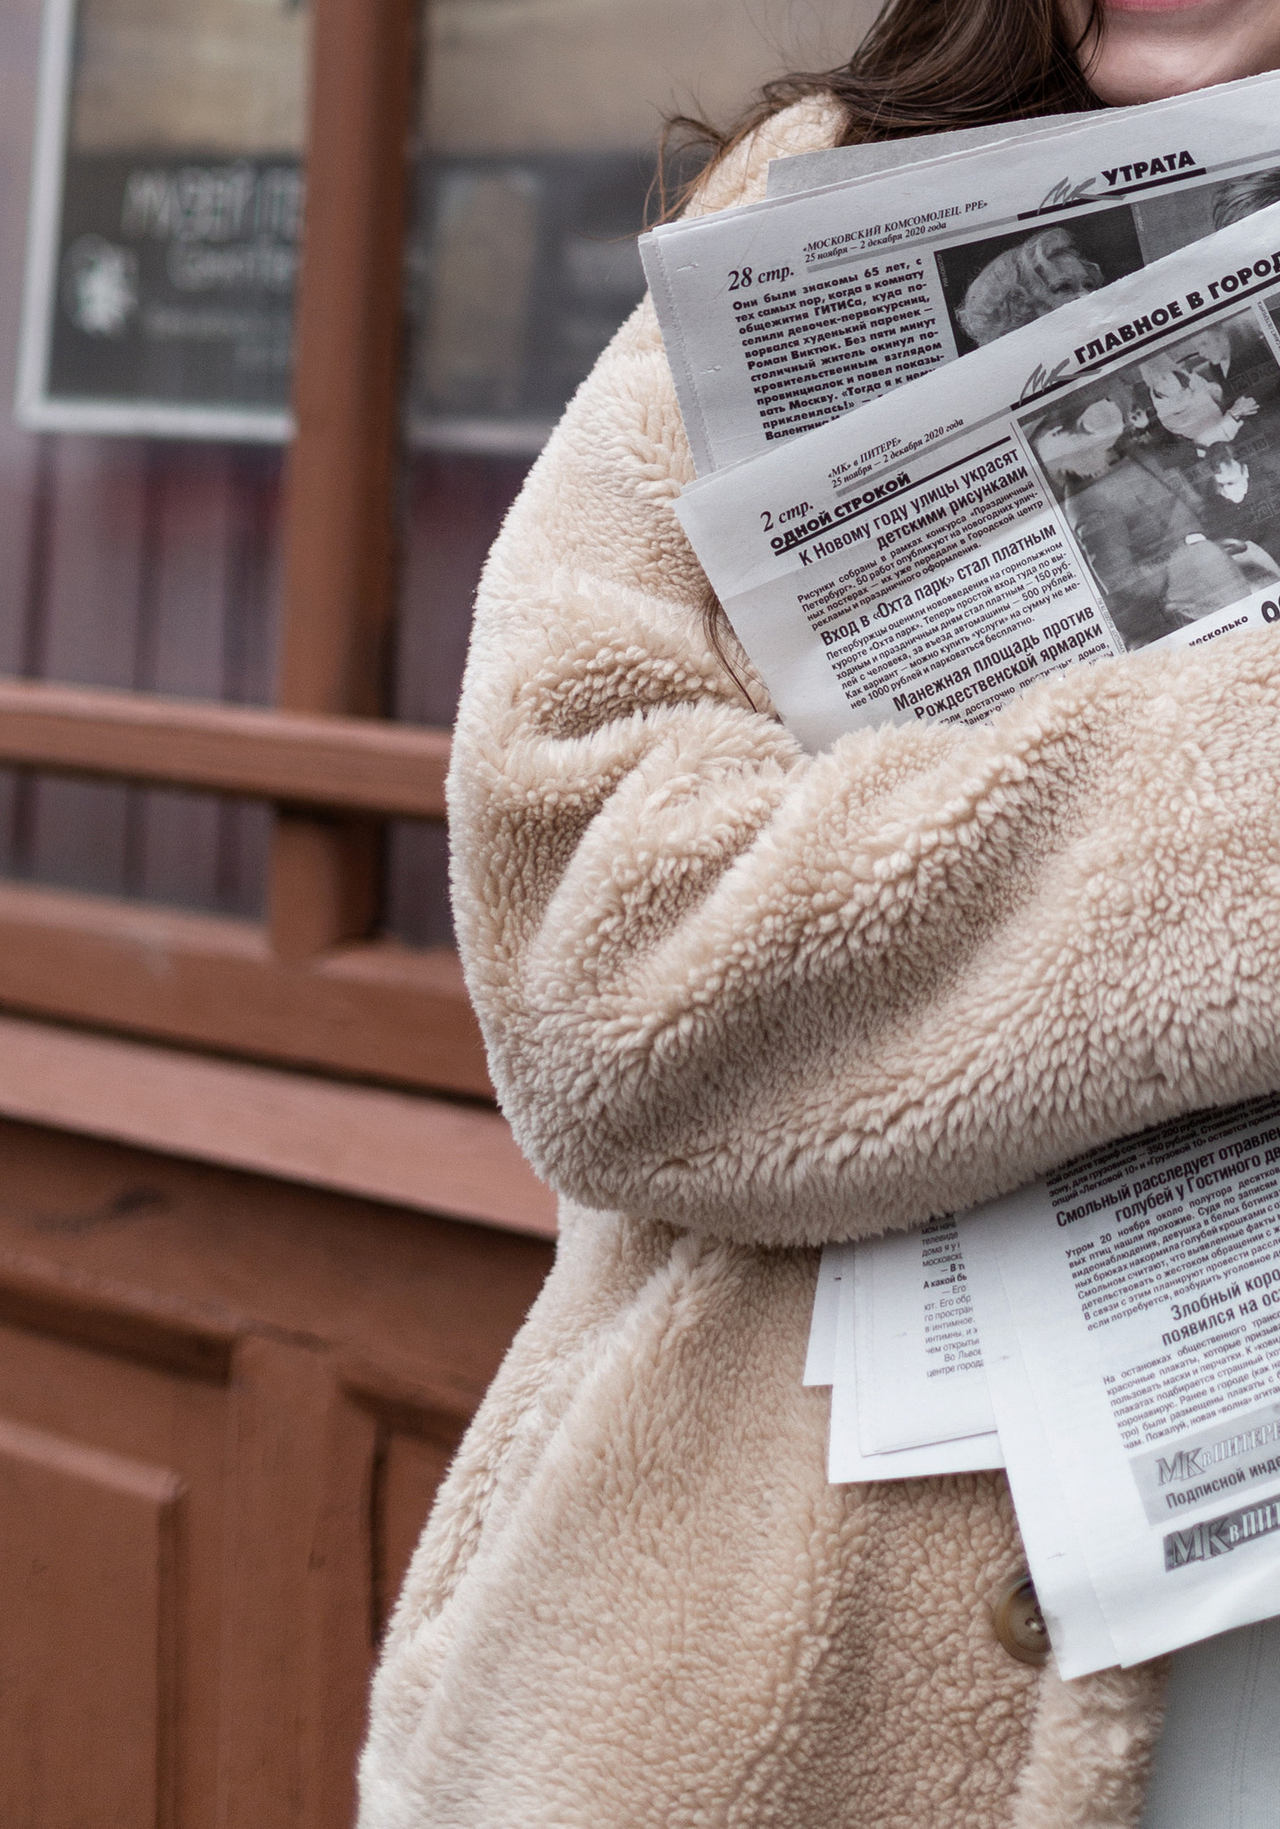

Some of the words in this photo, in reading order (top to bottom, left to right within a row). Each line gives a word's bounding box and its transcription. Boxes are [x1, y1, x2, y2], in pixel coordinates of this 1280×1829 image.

[1101, 150, 1196, 186] УТРАТА
[802, 224, 881, 251] «МОСКОВСКИЙ
[884, 205, 961, 232] КОМСОМОЛЕЦ.
[804, 252, 815, 263] 25
[817, 246, 848, 260] ноября
[859, 239, 865, 249] 2
[867, 233, 902, 247] декабря
[904, 224, 925, 238] 2020
[927, 221, 946, 232] года
[727, 266, 752, 291] 28
[757, 266, 794, 283] стр.
[732, 298, 758, 310] Они
[763, 289, 796, 303] были
[802, 273, 858, 294] знакомы
[863, 266, 879, 278] 65
[885, 261, 910, 273] лет,
[734, 312, 755, 322] тех
[757, 302, 796, 317] самых
[798, 296, 825, 307] пор,
[827, 285, 862, 300] когда
[864, 283, 872, 291] в
[873, 269, 924, 288] комнату
[738, 311, 809, 334] общежития
[813, 297, 866, 316] ГИТИСа,
[871, 288, 902, 302] куда
[907, 283, 927, 292] по-
[741, 330, 784, 346] селили
[787, 294, 930, 337] девочек-первокурсниц,
[744, 339, 800, 358] ворвался
[802, 320, 867, 344] худенький
[869, 308, 921, 327] паренек
[1073, 300, 1183, 364] ГЛАВНОЕ
[1185, 291, 1204, 310] В
[762, 400, 854, 429] приклеилась!»
[831, 476, 842, 488] 25
[843, 463, 872, 483] ноября
[882, 453, 888, 463] 2
[889, 438, 923, 459] декабря
[923, 426, 944, 442] 2020
[945, 418, 964, 432] года
[759, 510, 774, 532] 2
[778, 501, 813, 523] стр.
[770, 509, 833, 549] ОДНОЙ
[833, 471, 911, 517] СТРОКОЙ
[797, 548, 813, 566] К
[812, 522, 871, 559] Новому
[872, 503, 908, 529] году
[909, 478, 959, 514] улицы
[959, 448, 1018, 489] украсят
[876, 506, 947, 551] детскими
[948, 465, 1028, 515] рисунками
[796, 580, 835, 603] Рисунки
[838, 559, 877, 583] собраны
[889, 536, 923, 559] рамках
[925, 515, 967, 539] конкурса
[969, 480, 1034, 516] «Праздничный
[819, 620, 860, 646] Вход
[859, 614, 870, 627] в
[872, 593, 913, 619] «Охта
[913, 575, 954, 601] парк»
[956, 556, 990, 580] стал
[991, 524, 1056, 563] платным
[892, 665, 971, 711] Манежная
[972, 634, 1040, 673] площадь
[1041, 606, 1094, 639] против
[913, 652, 1038, 719] Рождественской
[1039, 623, 1102, 662] ярмарки
[1055, 1183, 1131, 1227] Смольный
[1132, 1151, 1214, 1197] расследует
[1064, 1241, 1094, 1258] Утром
[1099, 1232, 1112, 1244] 20
[1117, 1218, 1150, 1237] ноября
[1155, 1205, 1183, 1221] около
[1188, 1185, 1232, 1208] полутора
[1237, 1166, 1280, 1190] десятков
[1114, 1192, 1165, 1222] голубей
[1162, 1185, 1174, 1202] у
[1174, 1154, 1261, 1201] Гостиного
[1161, 1307, 1235, 1346] появился
[1238, 1298, 1258, 1316] на
[1170, 1284, 1241, 1320] Злобный
[1165, 1467, 1246, 1508] Подписной
